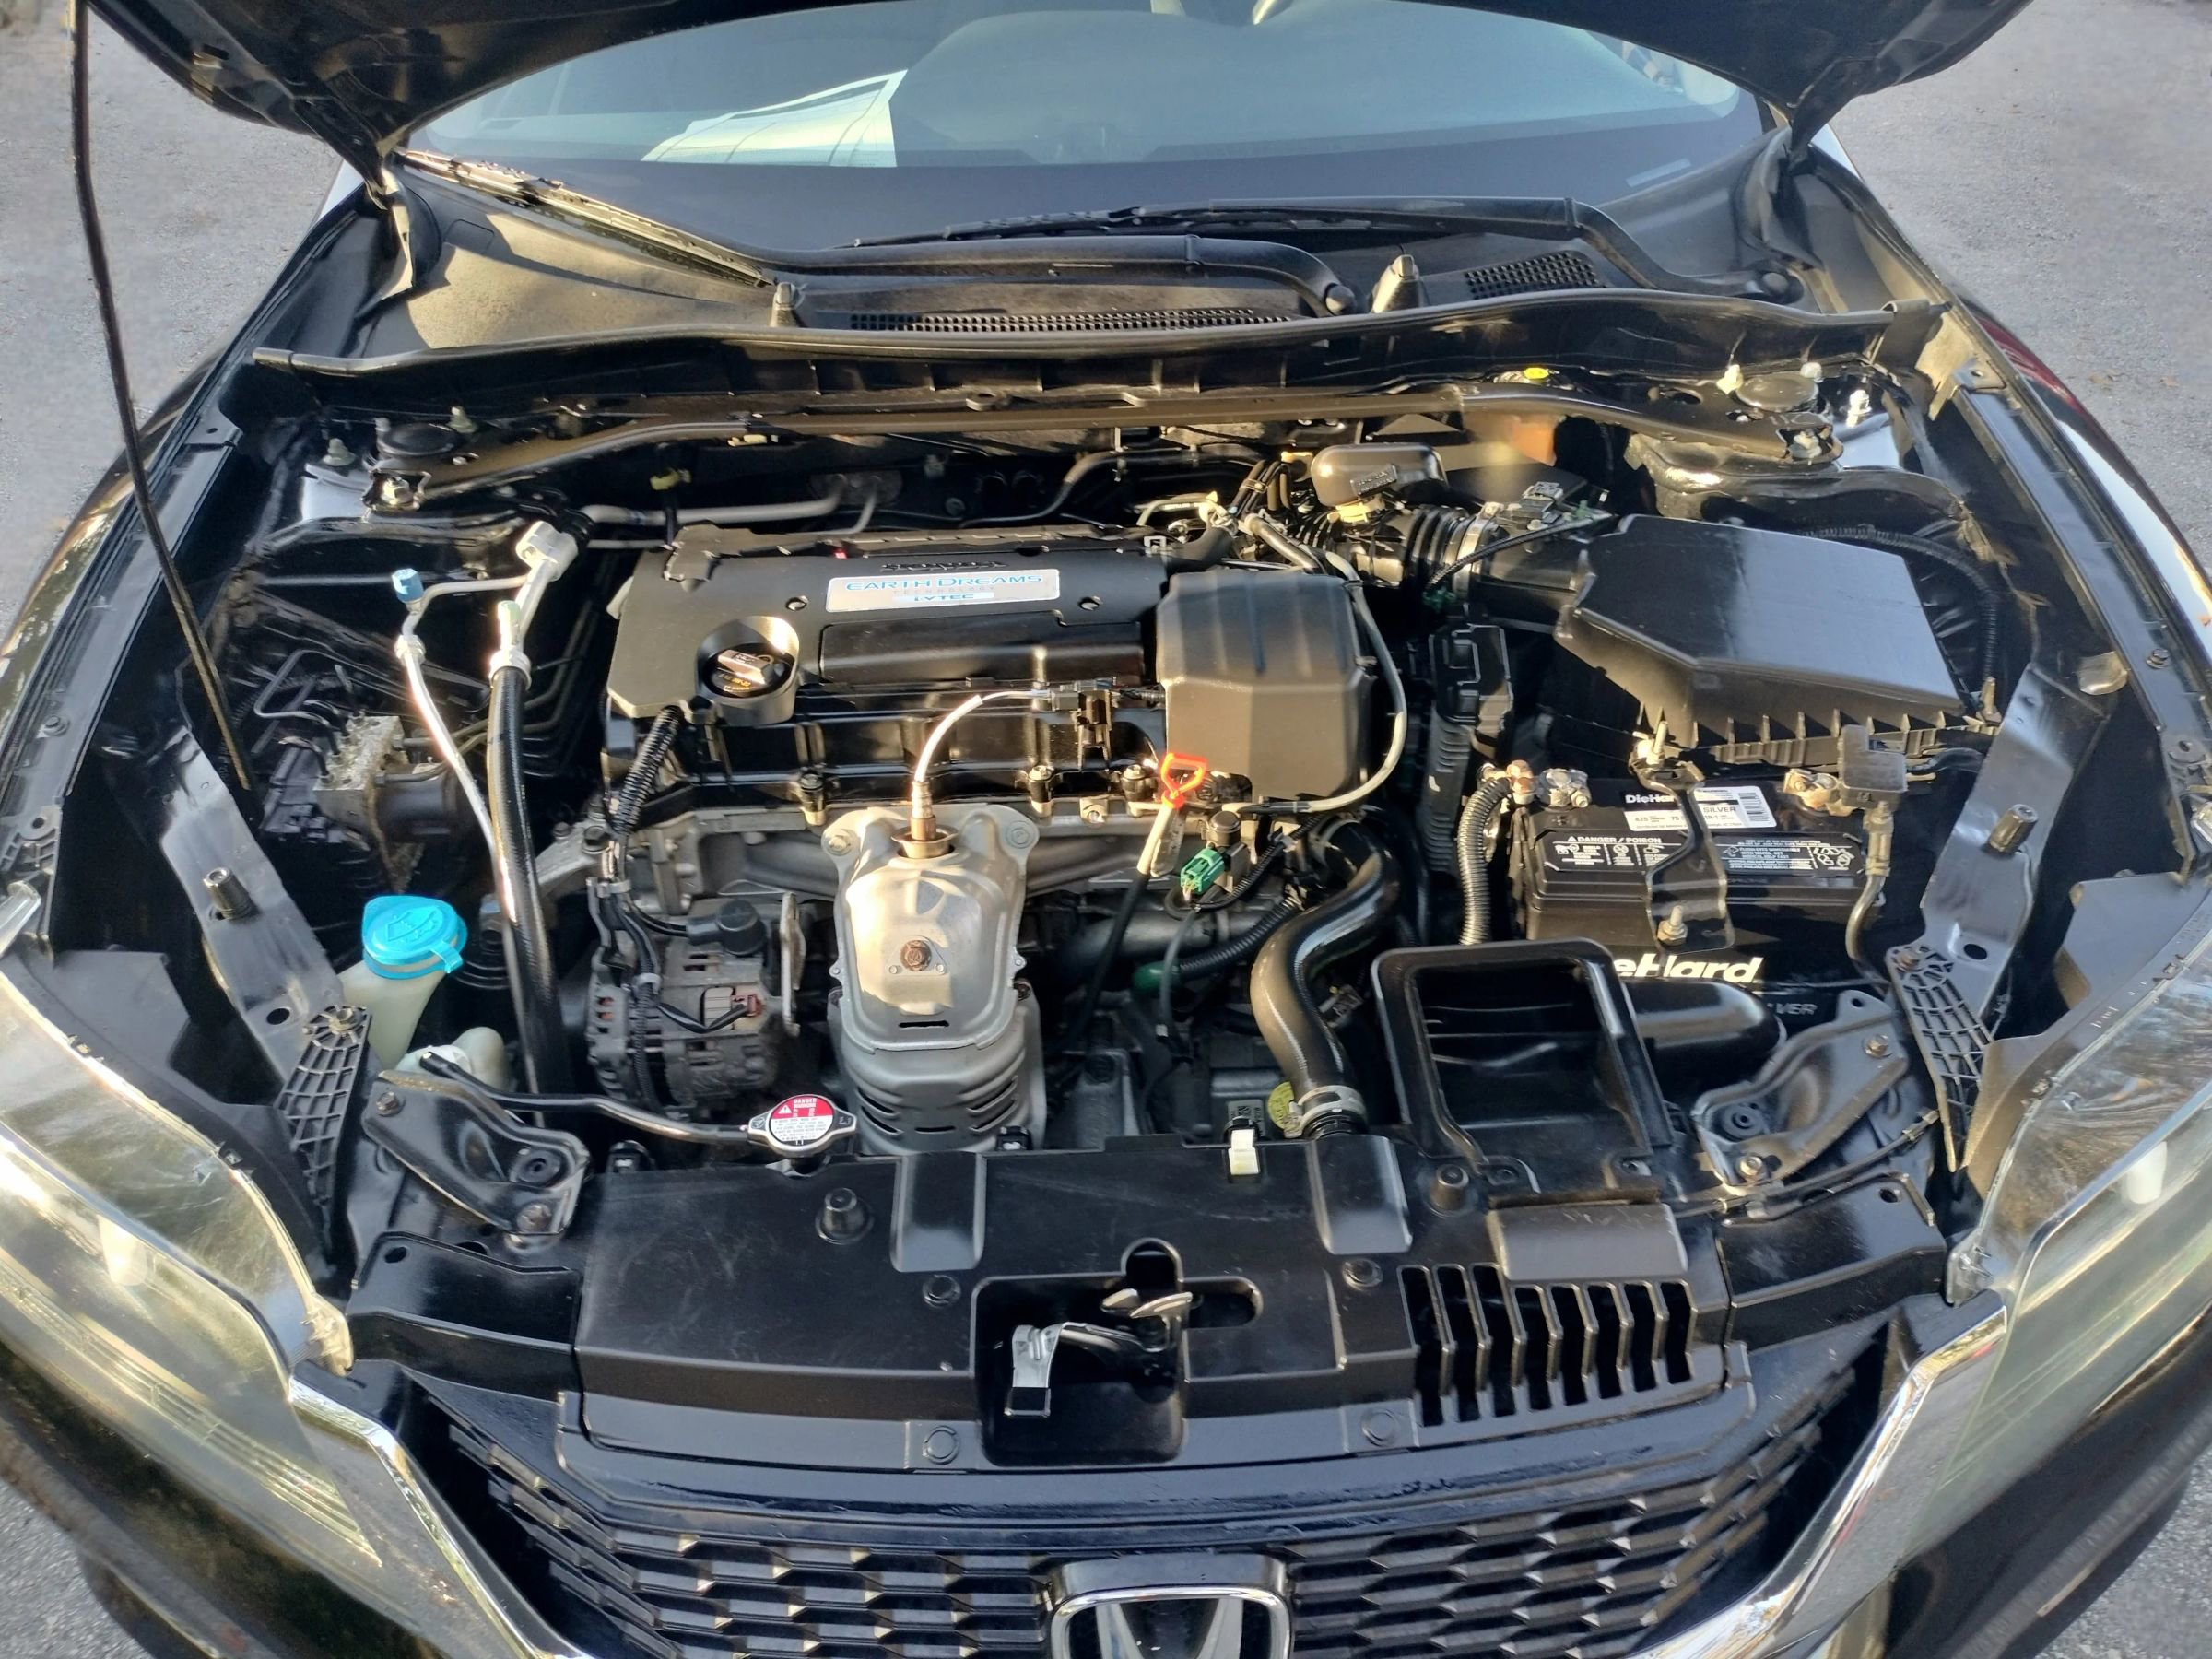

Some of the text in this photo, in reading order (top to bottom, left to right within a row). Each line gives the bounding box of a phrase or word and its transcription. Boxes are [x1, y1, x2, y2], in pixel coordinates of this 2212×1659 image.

[846, 575, 1042, 591] EARTH DREAMS
[1625, 794, 1675, 804] DieHar
[1613, 953, 1764, 982] eHard
[1767, 1002, 1818, 1015] VER
